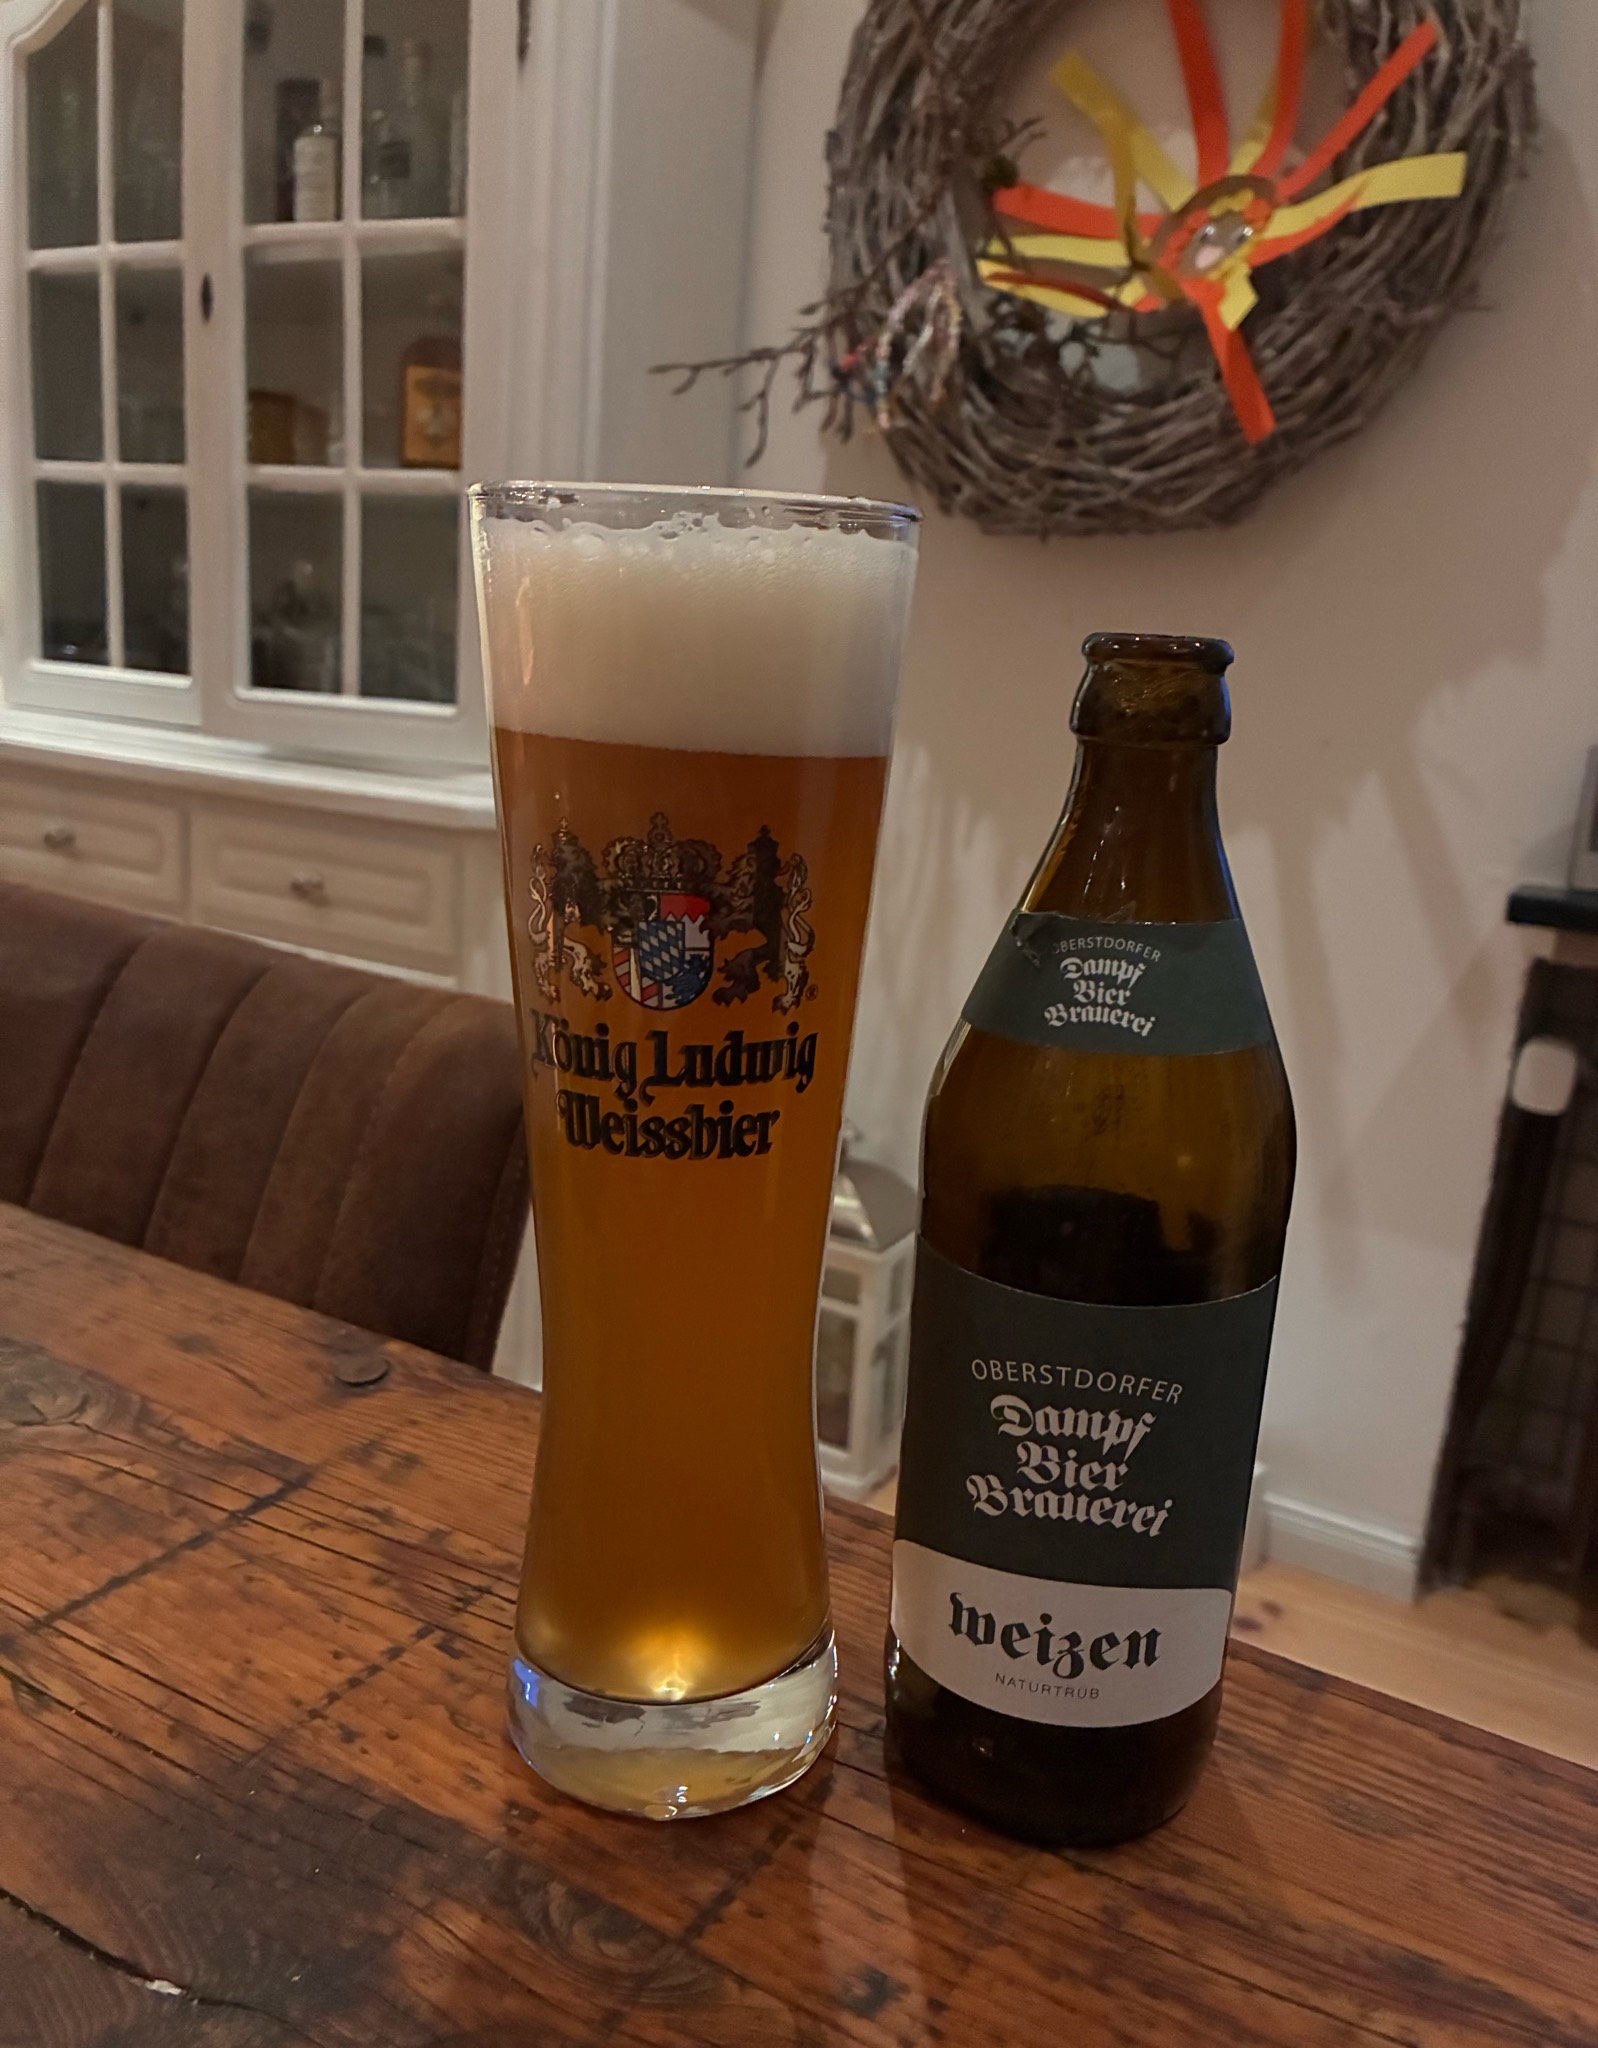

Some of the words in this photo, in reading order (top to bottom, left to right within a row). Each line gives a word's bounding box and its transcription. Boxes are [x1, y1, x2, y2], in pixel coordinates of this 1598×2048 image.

[1060, 957, 1147, 989] Dampf
[1073, 979, 1131, 1006] Bier
[1044, 1003, 1156, 1037] Brauerei
[531, 1006, 638, 1100] König
[639, 1021, 818, 1105] Ludwig
[555, 1089, 781, 1160] Weissbier
[971, 1359, 1183, 1404] OBERSTDORFER
[990, 1394, 1156, 1461] Dampf
[1016, 1441, 1129, 1492] Bier
[966, 1474, 1173, 1537] Brauerei
